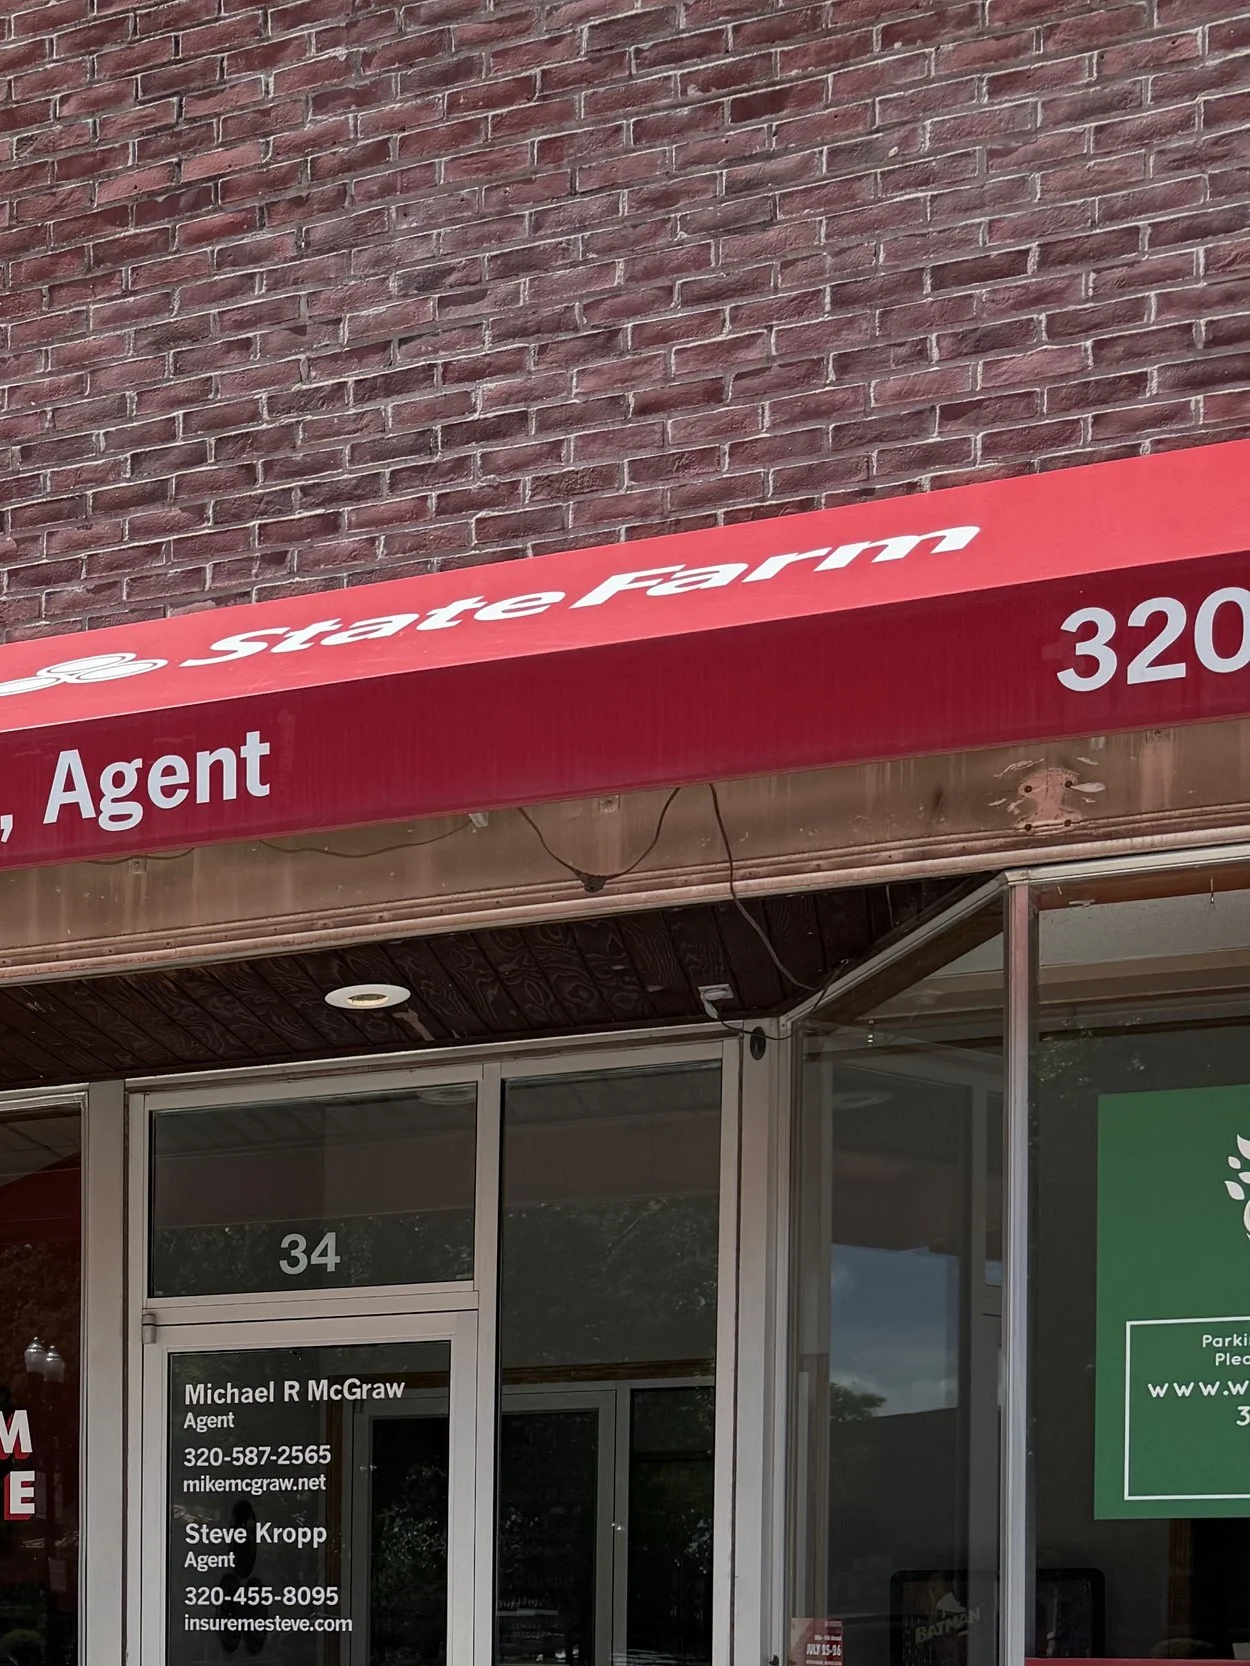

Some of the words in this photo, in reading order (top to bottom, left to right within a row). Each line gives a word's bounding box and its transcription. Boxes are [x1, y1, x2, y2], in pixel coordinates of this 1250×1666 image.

[1056, 586, 1250, 692] 320
[43, 731, 271, 831] Agent
[279, 1231, 341, 1275] 34
[1202, 1333, 1250, 1348] Parki
[184, 1381, 275, 1405] Michael
[284, 1380, 300, 1402] R
[307, 1377, 406, 1401] McGraw
[183, 1411, 235, 1433] Agent
[183, 1444, 332, 1467] 320-587-2565
[183, 1474, 327, 1495] mikemcgraw.net
[184, 1522, 247, 1546] Steve
[255, 1522, 328, 1549] Kropp
[183, 1551, 236, 1572] Agent
[184, 1586, 339, 1607] 320-455-8095
[183, 1613, 353, 1633] insuremesteve.com
